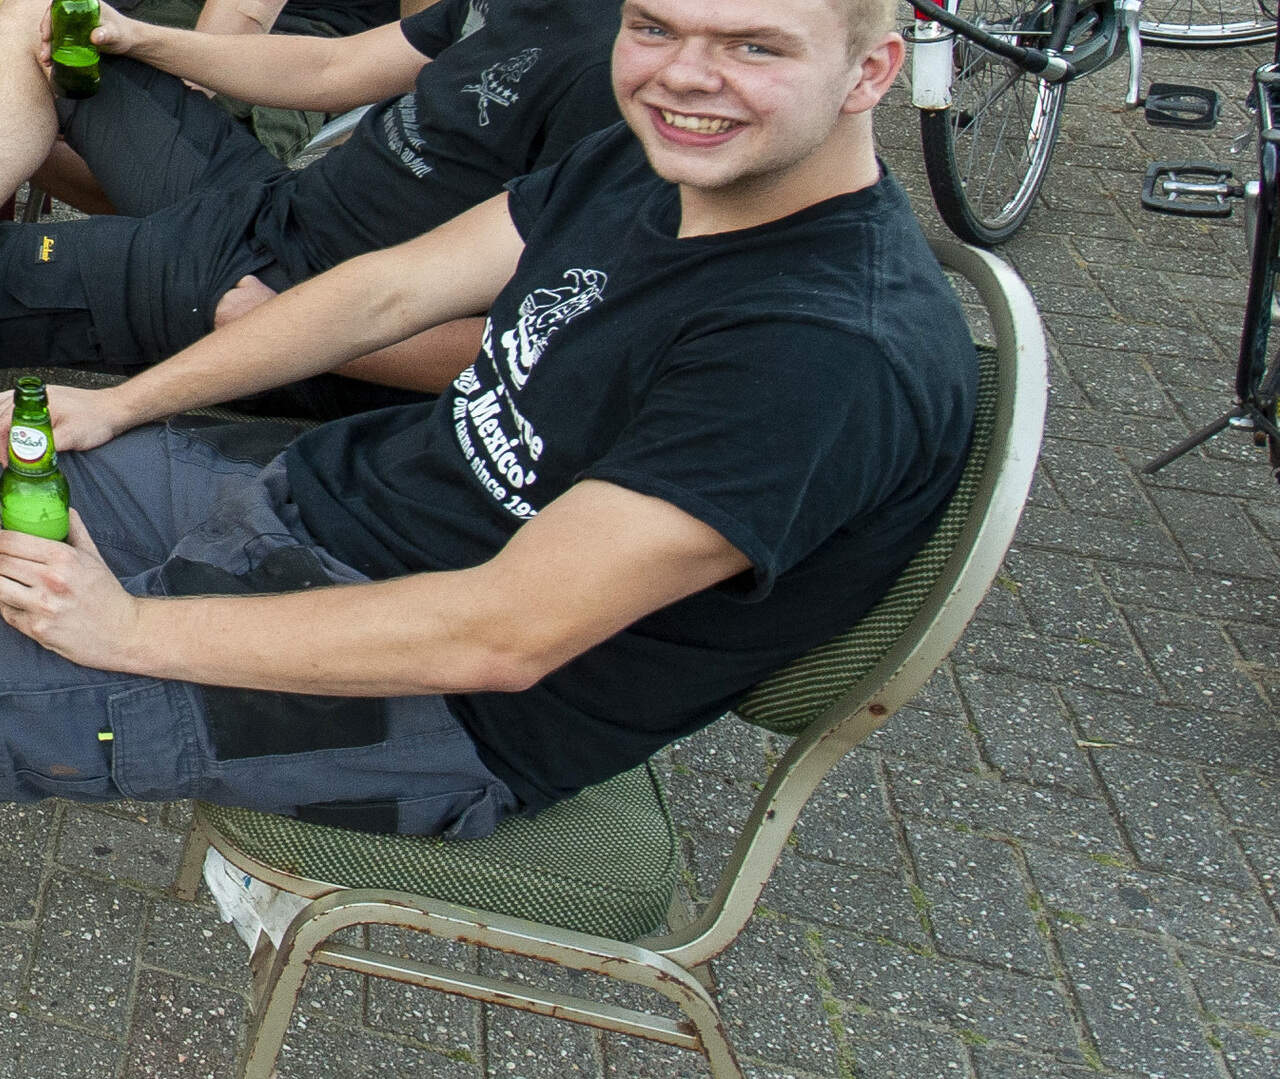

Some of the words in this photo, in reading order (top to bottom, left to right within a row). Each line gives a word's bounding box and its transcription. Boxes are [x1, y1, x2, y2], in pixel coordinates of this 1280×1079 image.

[453, 397, 469, 420] our
[455, 422, 476, 460] name
[471, 458, 507, 501] since
